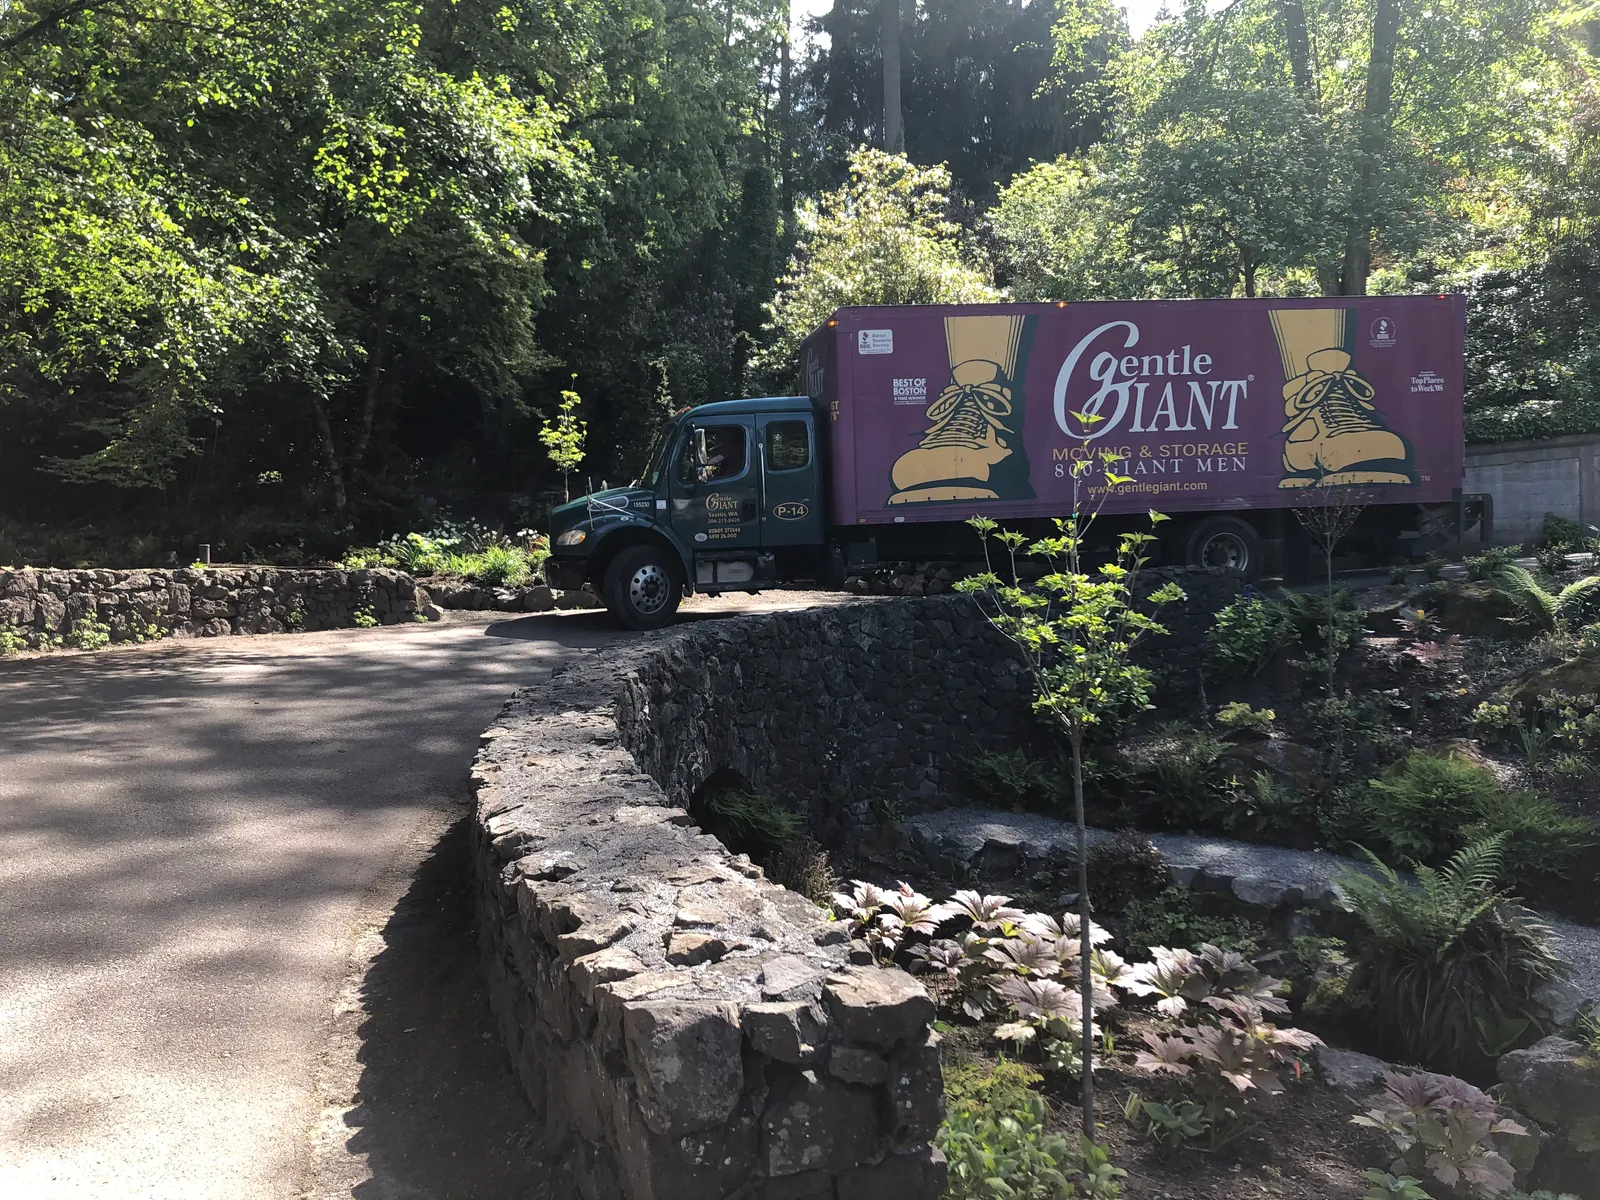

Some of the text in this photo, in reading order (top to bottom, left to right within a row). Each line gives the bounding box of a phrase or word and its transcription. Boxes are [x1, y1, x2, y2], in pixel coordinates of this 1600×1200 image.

[893, 378, 926, 387] BEST OF
[893, 387, 927, 395] BOSTON
[1052, 442, 1249, 461] MOVING & STORAGE
[1196, 456, 1247, 473] MEN
[1087, 481, 1208, 496] www.gentlegiant.com
[777, 506, 805, 516] P-14
